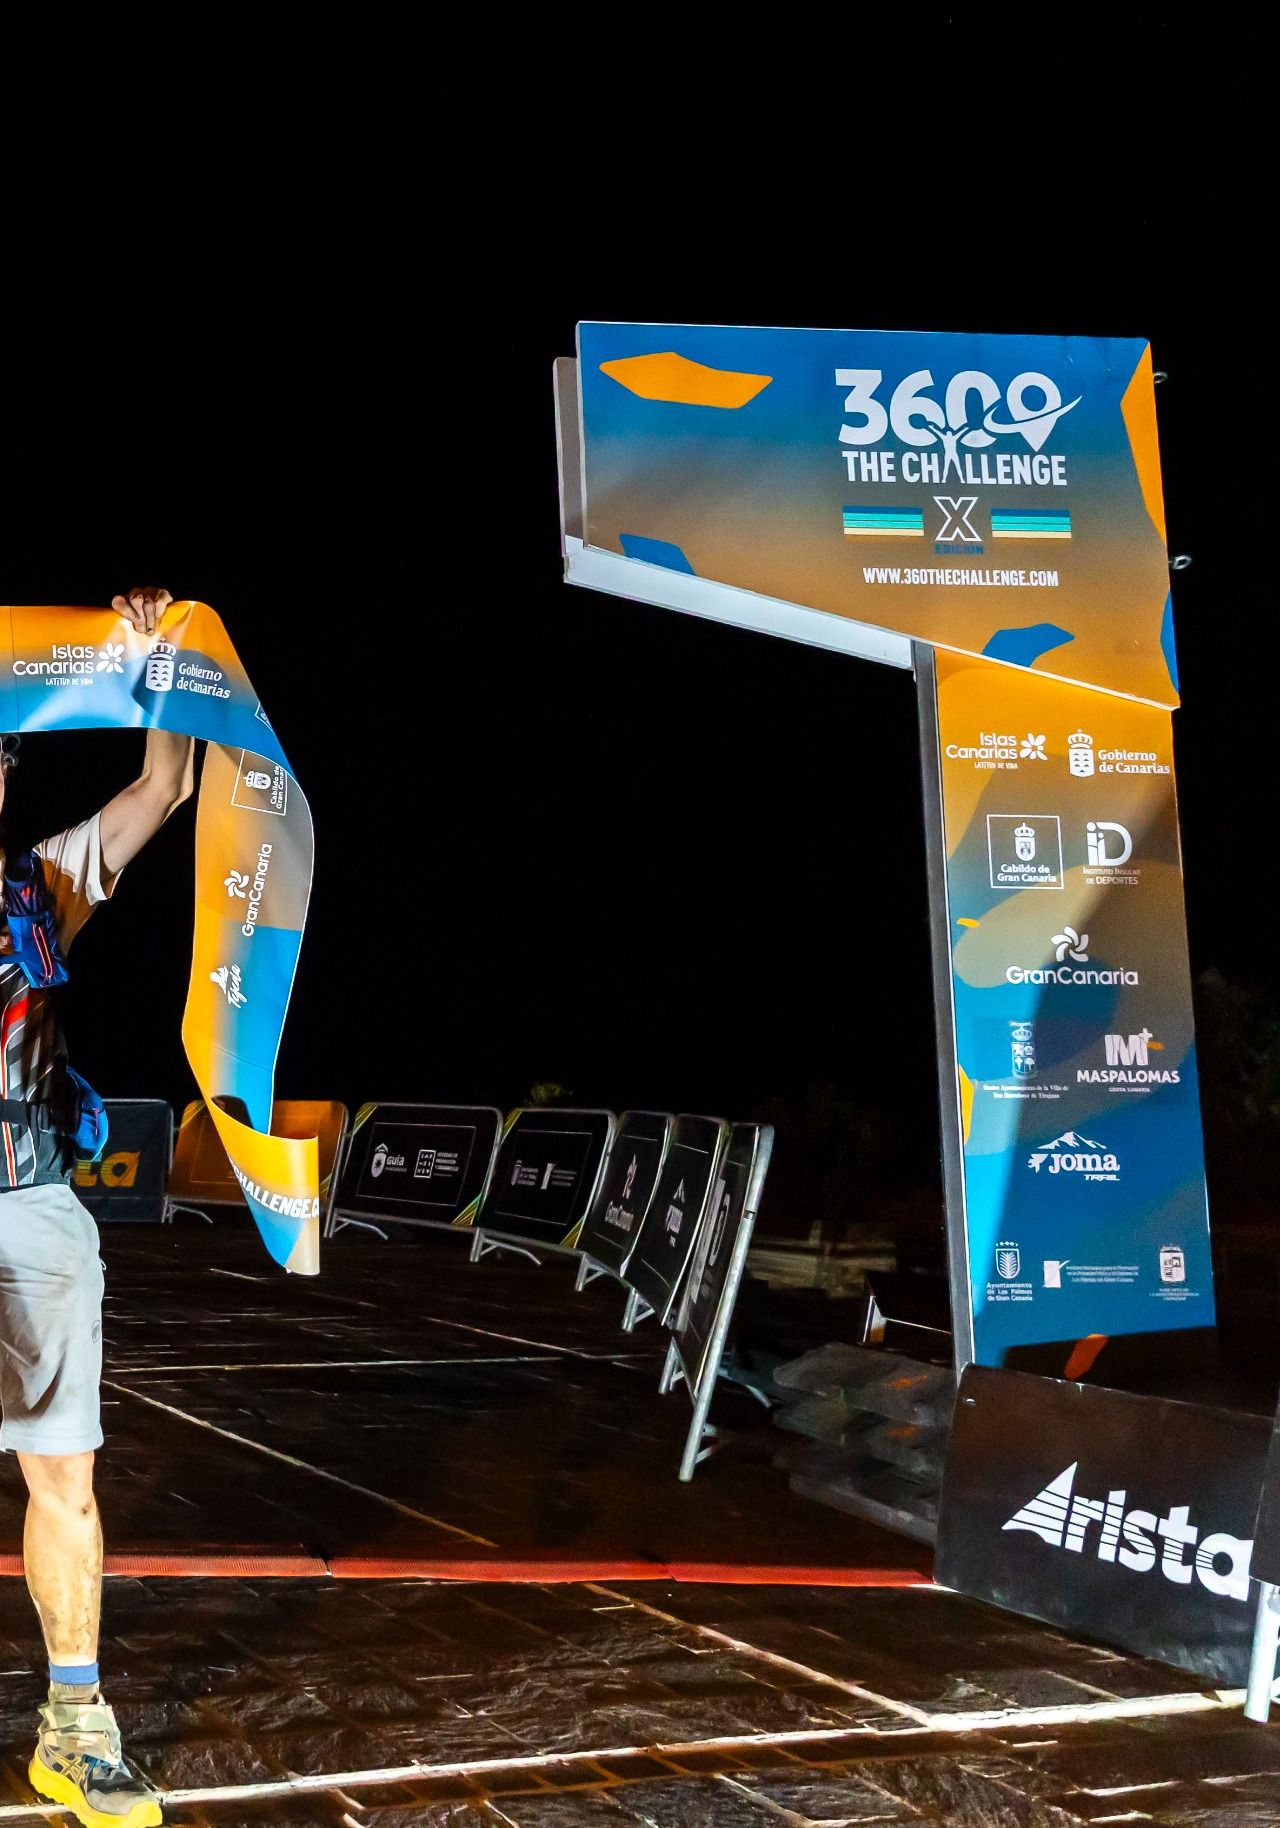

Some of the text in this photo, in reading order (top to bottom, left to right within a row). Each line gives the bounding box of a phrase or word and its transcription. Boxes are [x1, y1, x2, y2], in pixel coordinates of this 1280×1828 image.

[842, 450, 895, 483] THE
[933, 496, 982, 541] X
[863, 567, 1059, 587] WWW.360THECHALLENGE.COM
[52, 644, 94, 660] Islas
[12, 658, 94, 677] Canarias
[179, 662, 223, 681] Gobierno
[177, 677, 231, 699] de Canarias
[980, 733, 1017, 746] Islas
[946, 745, 1018, 759] Canarias
[1098, 749, 1157, 761] Gobierno
[1099, 762, 1170, 774] de Canarias
[270, 776, 280, 804] Cabildo
[276, 790, 285, 809] Gran
[997, 873, 1057, 883] Gran Canaria
[1001, 864, 1050, 873] Cabildo de
[241, 843, 273, 936] GranCanaria
[1096, 877, 1138, 885] DEPORTES
[1006, 966, 1139, 985] GranCanaria
[1077, 1070, 1180, 1083] MASPALOMAS
[1001, 1461, 1254, 1602] Arista
